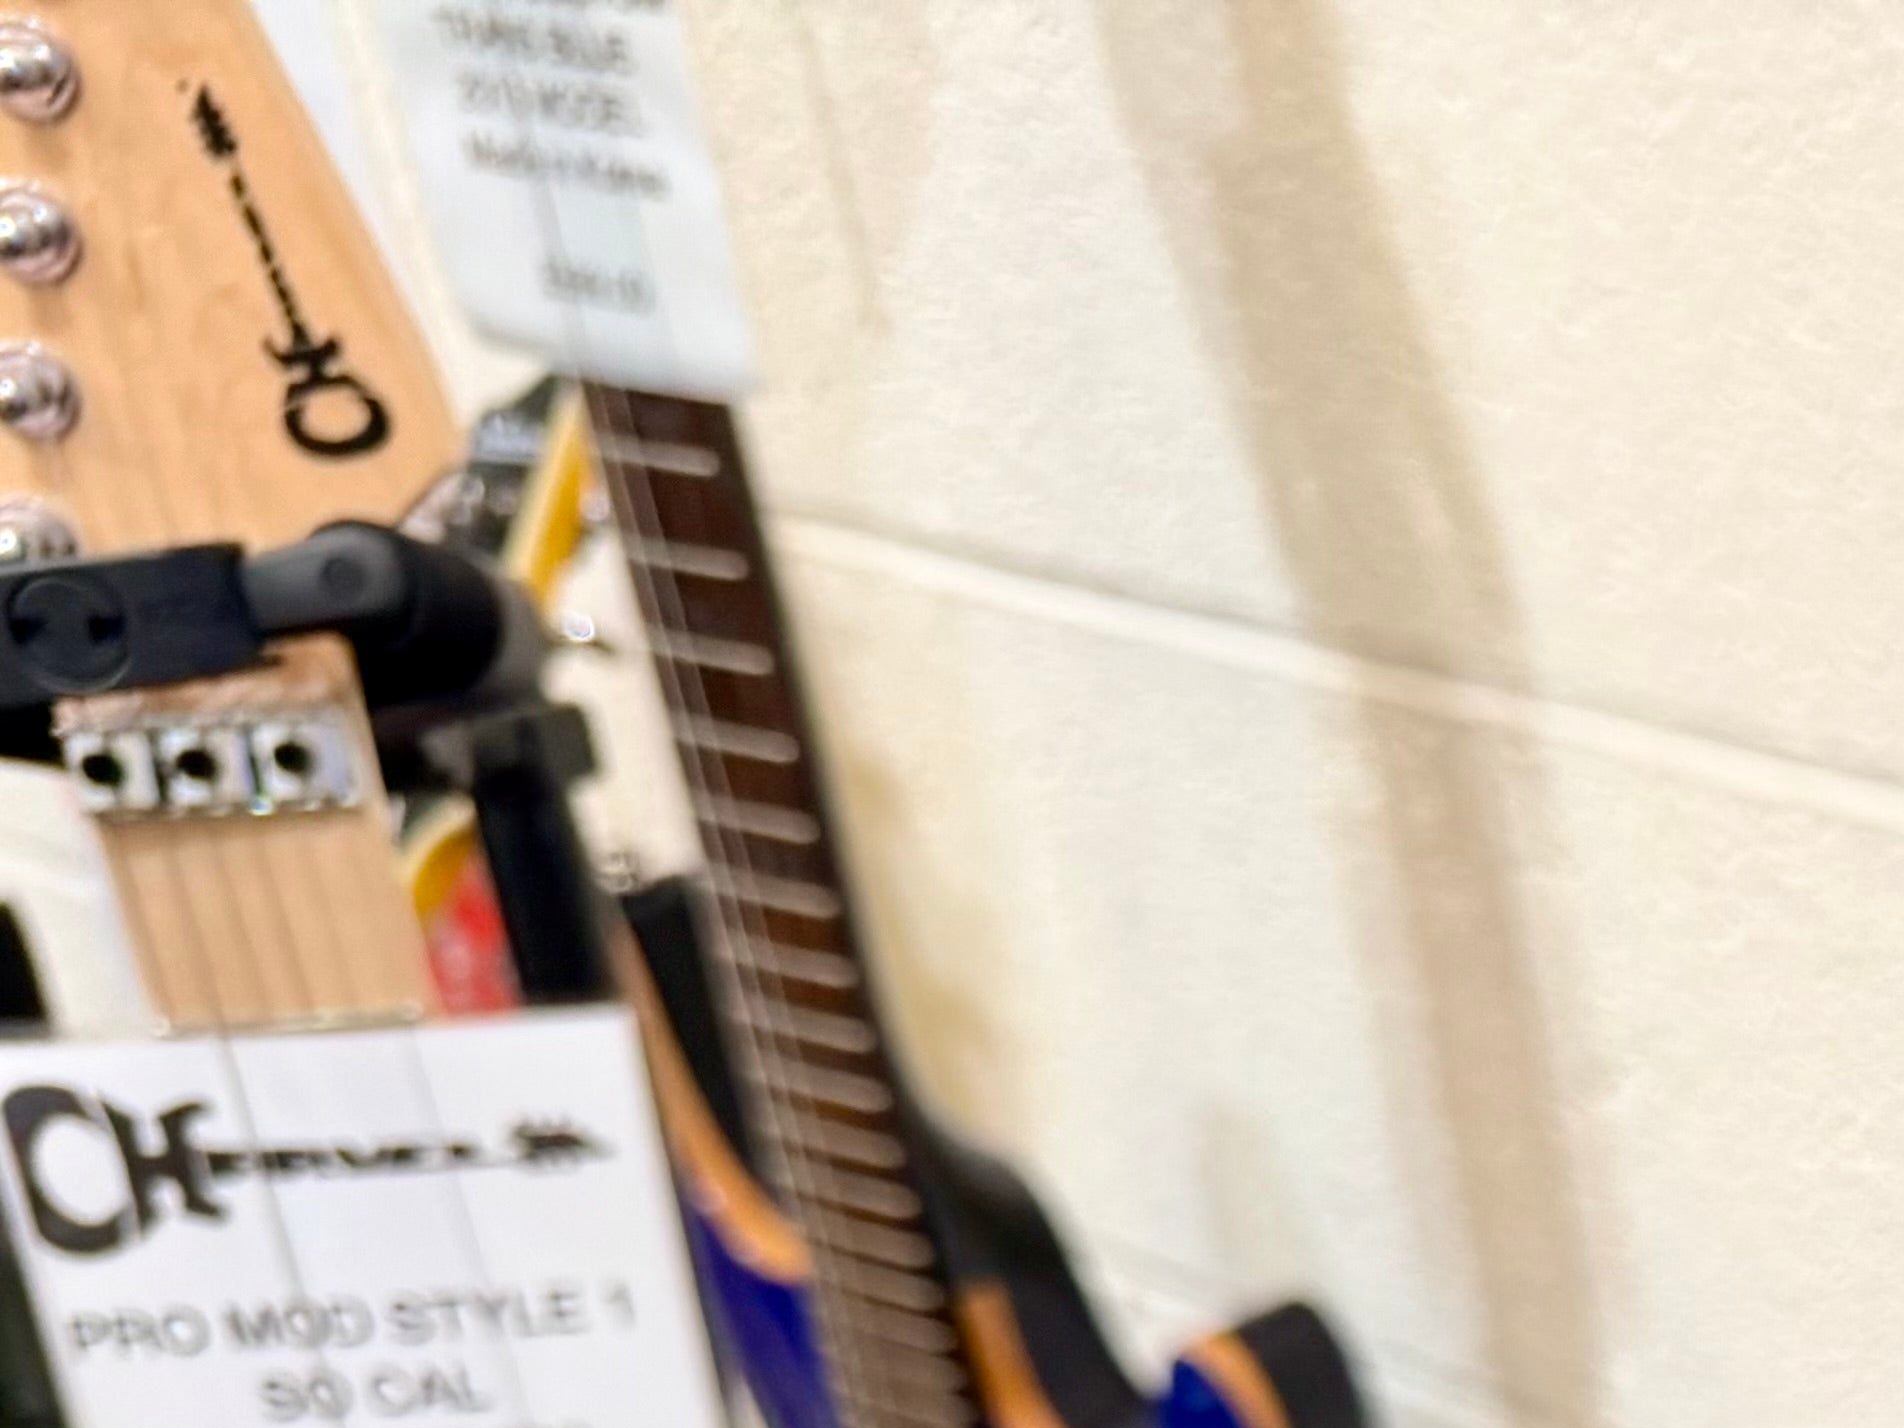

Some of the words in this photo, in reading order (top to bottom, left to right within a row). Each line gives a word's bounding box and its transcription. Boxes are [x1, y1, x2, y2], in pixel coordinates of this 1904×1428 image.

[67, 1303, 212, 1358] PRO
[223, 1291, 375, 1350] MOD
[384, 1283, 590, 1347] STYLE
[259, 1364, 353, 1422] SO
[366, 1360, 494, 1419] CAL
